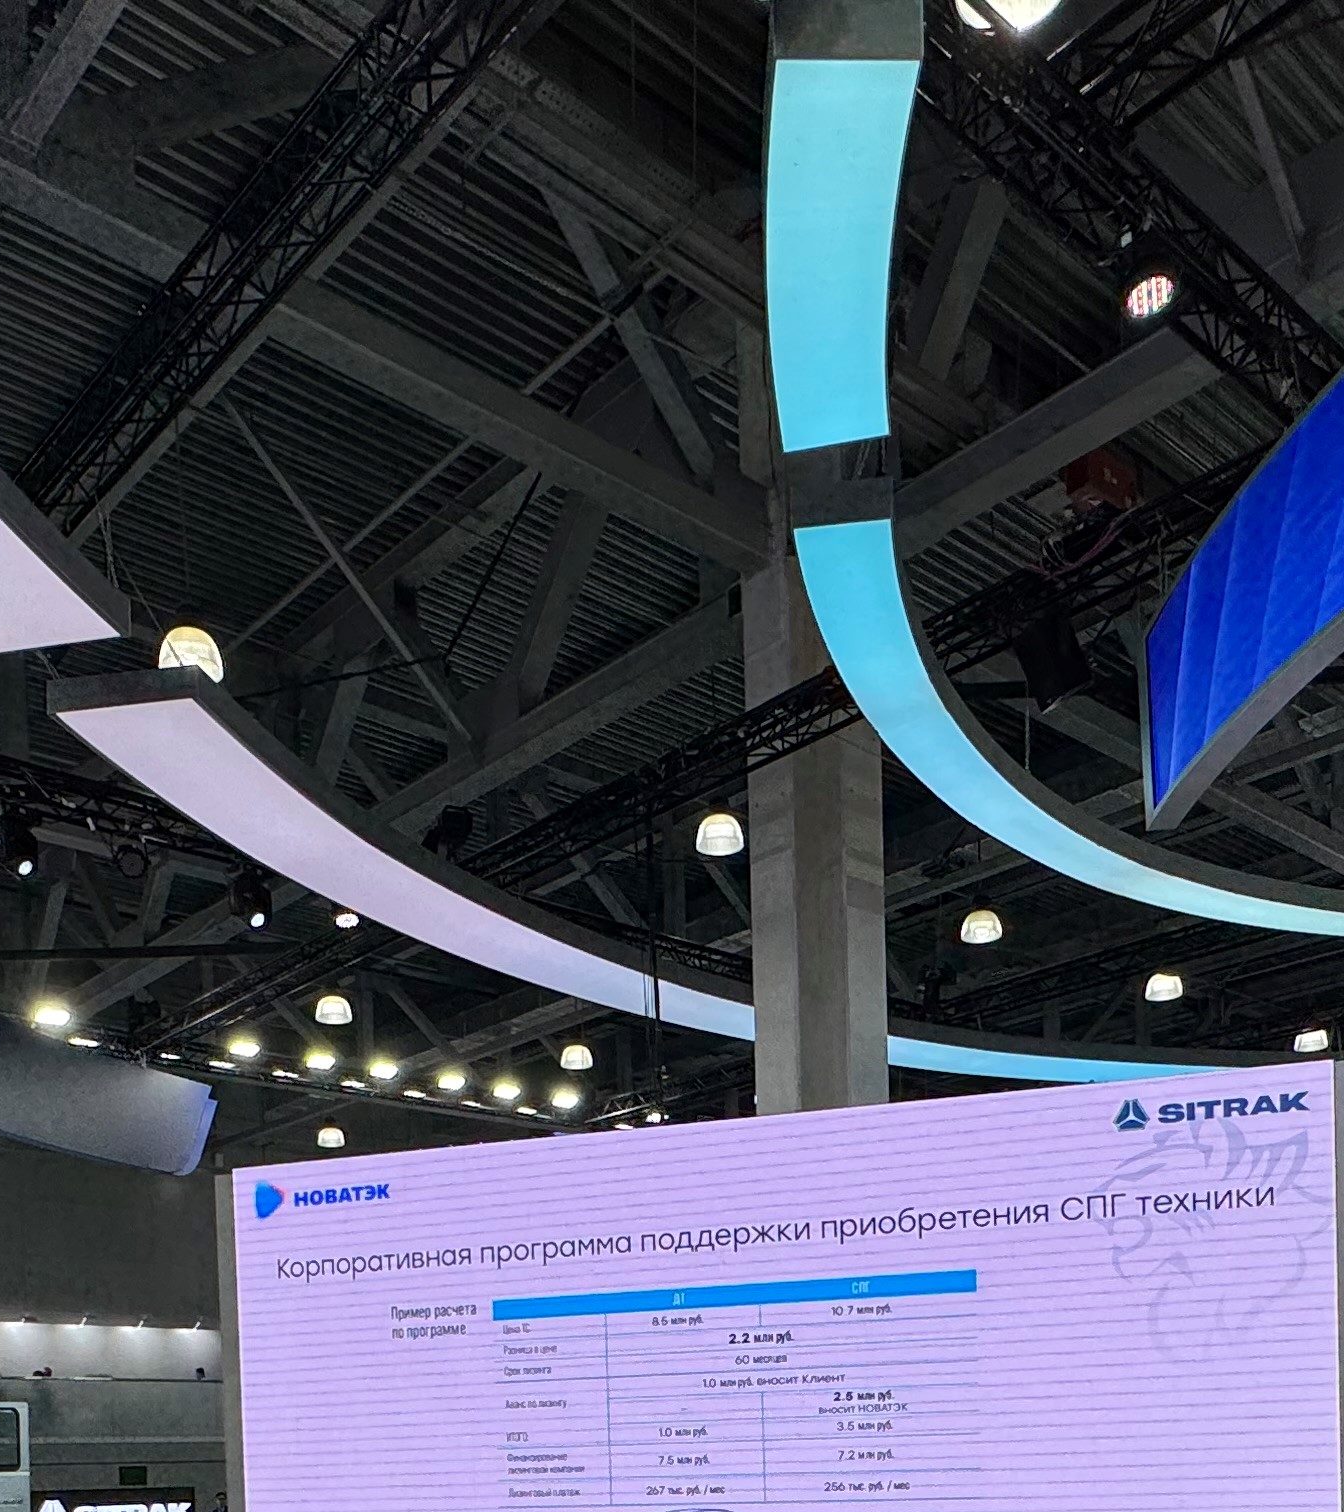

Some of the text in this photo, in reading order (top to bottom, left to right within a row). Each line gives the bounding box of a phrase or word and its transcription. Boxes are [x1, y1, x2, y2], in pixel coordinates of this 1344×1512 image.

[1157, 1091, 1311, 1125] SITRAK
[293, 1183, 390, 1208] НОВАТЭК
[277, 1185, 1276, 1283] Корпоративная программа поддержки приобретения СПГ техники
[390, 1303, 477, 1321] Пример расчета
[392, 1323, 467, 1342] по программе
[728, 1330, 794, 1345] 2.2 млн руб.
[735, 1354, 750, 1365] 60
[757, 1376, 799, 1386] вносит
[801, 1374, 846, 1384] Клиент
[833, 1391, 854, 1402] 2.5
[857, 1392, 876, 1401] млн
[818, 1402, 908, 1415] вносит НОВАТЭК
[658, 1427, 672, 1438] 1.0
[836, 1422, 855, 1432] 3.5
[658, 1455, 674, 1466] 7.5
[838, 1450, 855, 1461] 7.2
[646, 1485, 665, 1496] 267
[824, 1482, 846, 1492] 256
